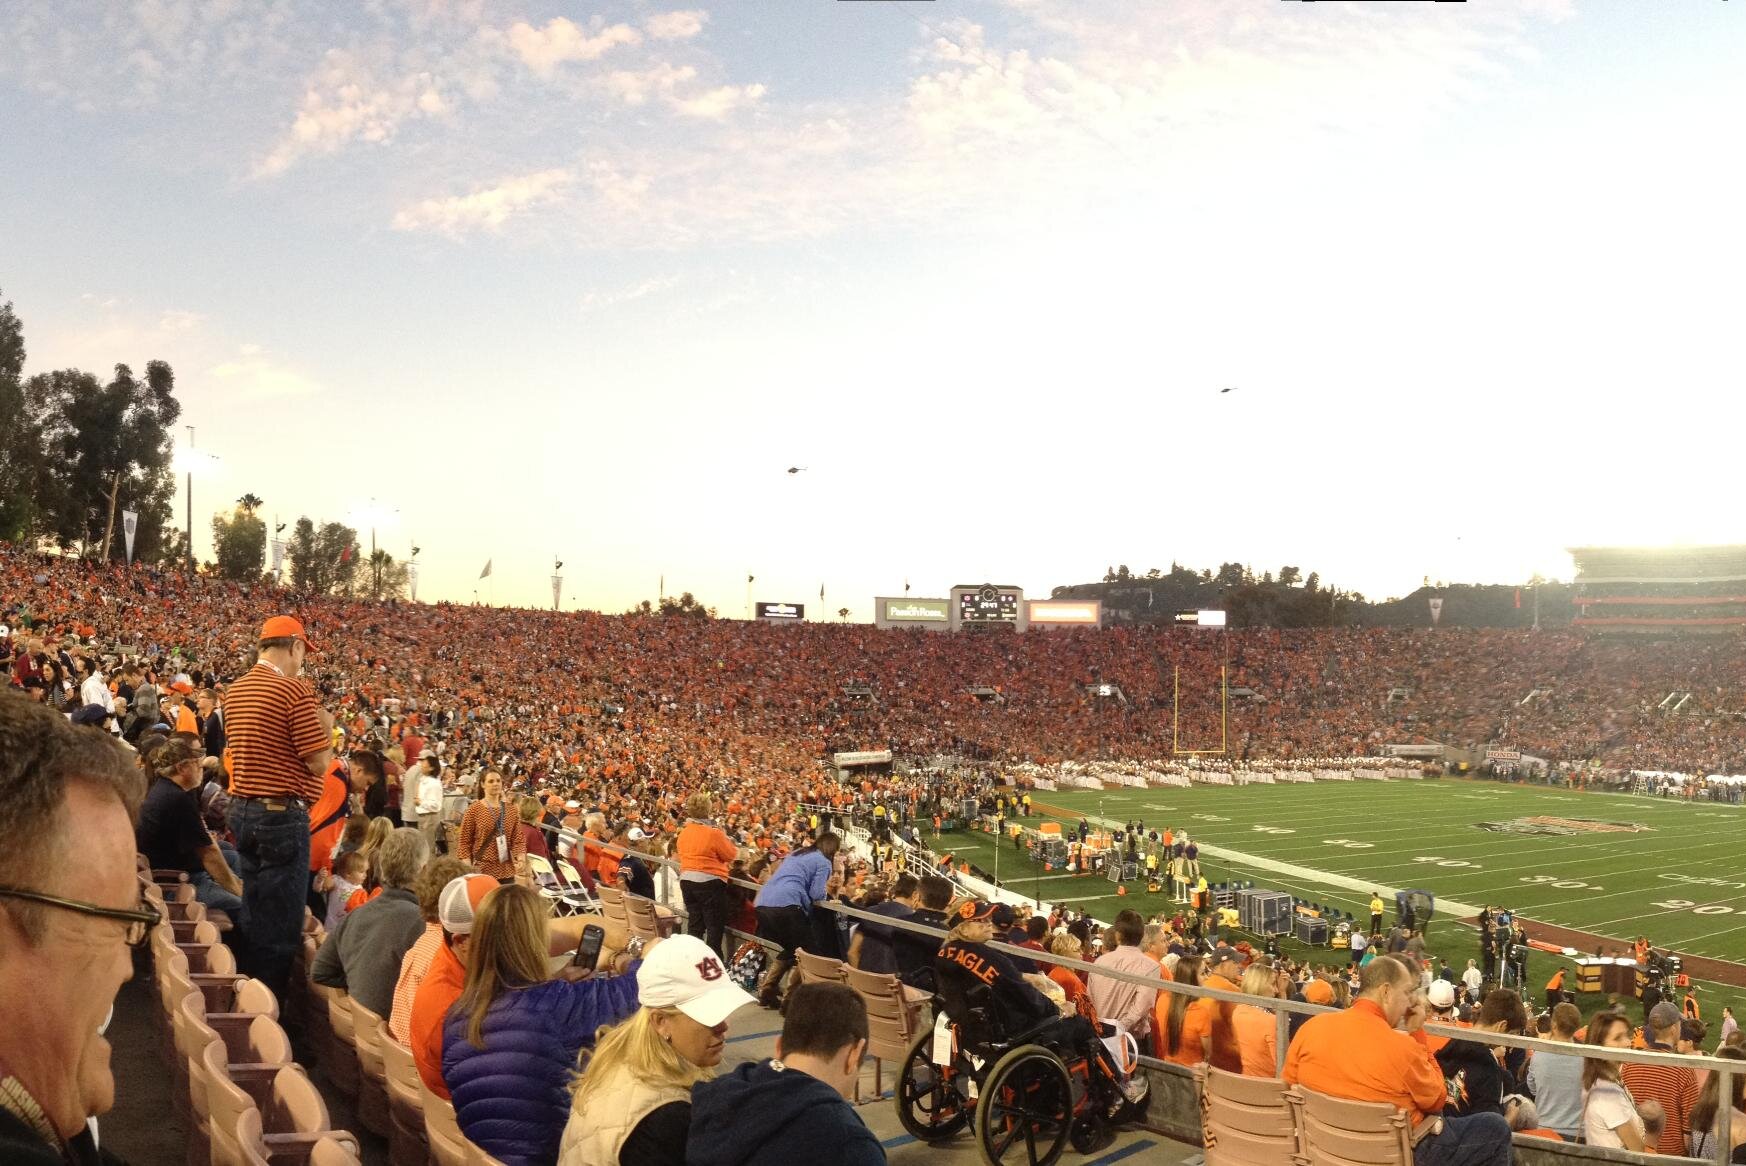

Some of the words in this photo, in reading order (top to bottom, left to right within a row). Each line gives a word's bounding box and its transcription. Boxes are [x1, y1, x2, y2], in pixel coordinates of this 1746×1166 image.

[1487, 751, 1519, 759] HONDA
[1519, 875, 1589, 889] 30
[1650, 899, 1734, 915] 20
[946, 946, 1000, 985] EAGLE
